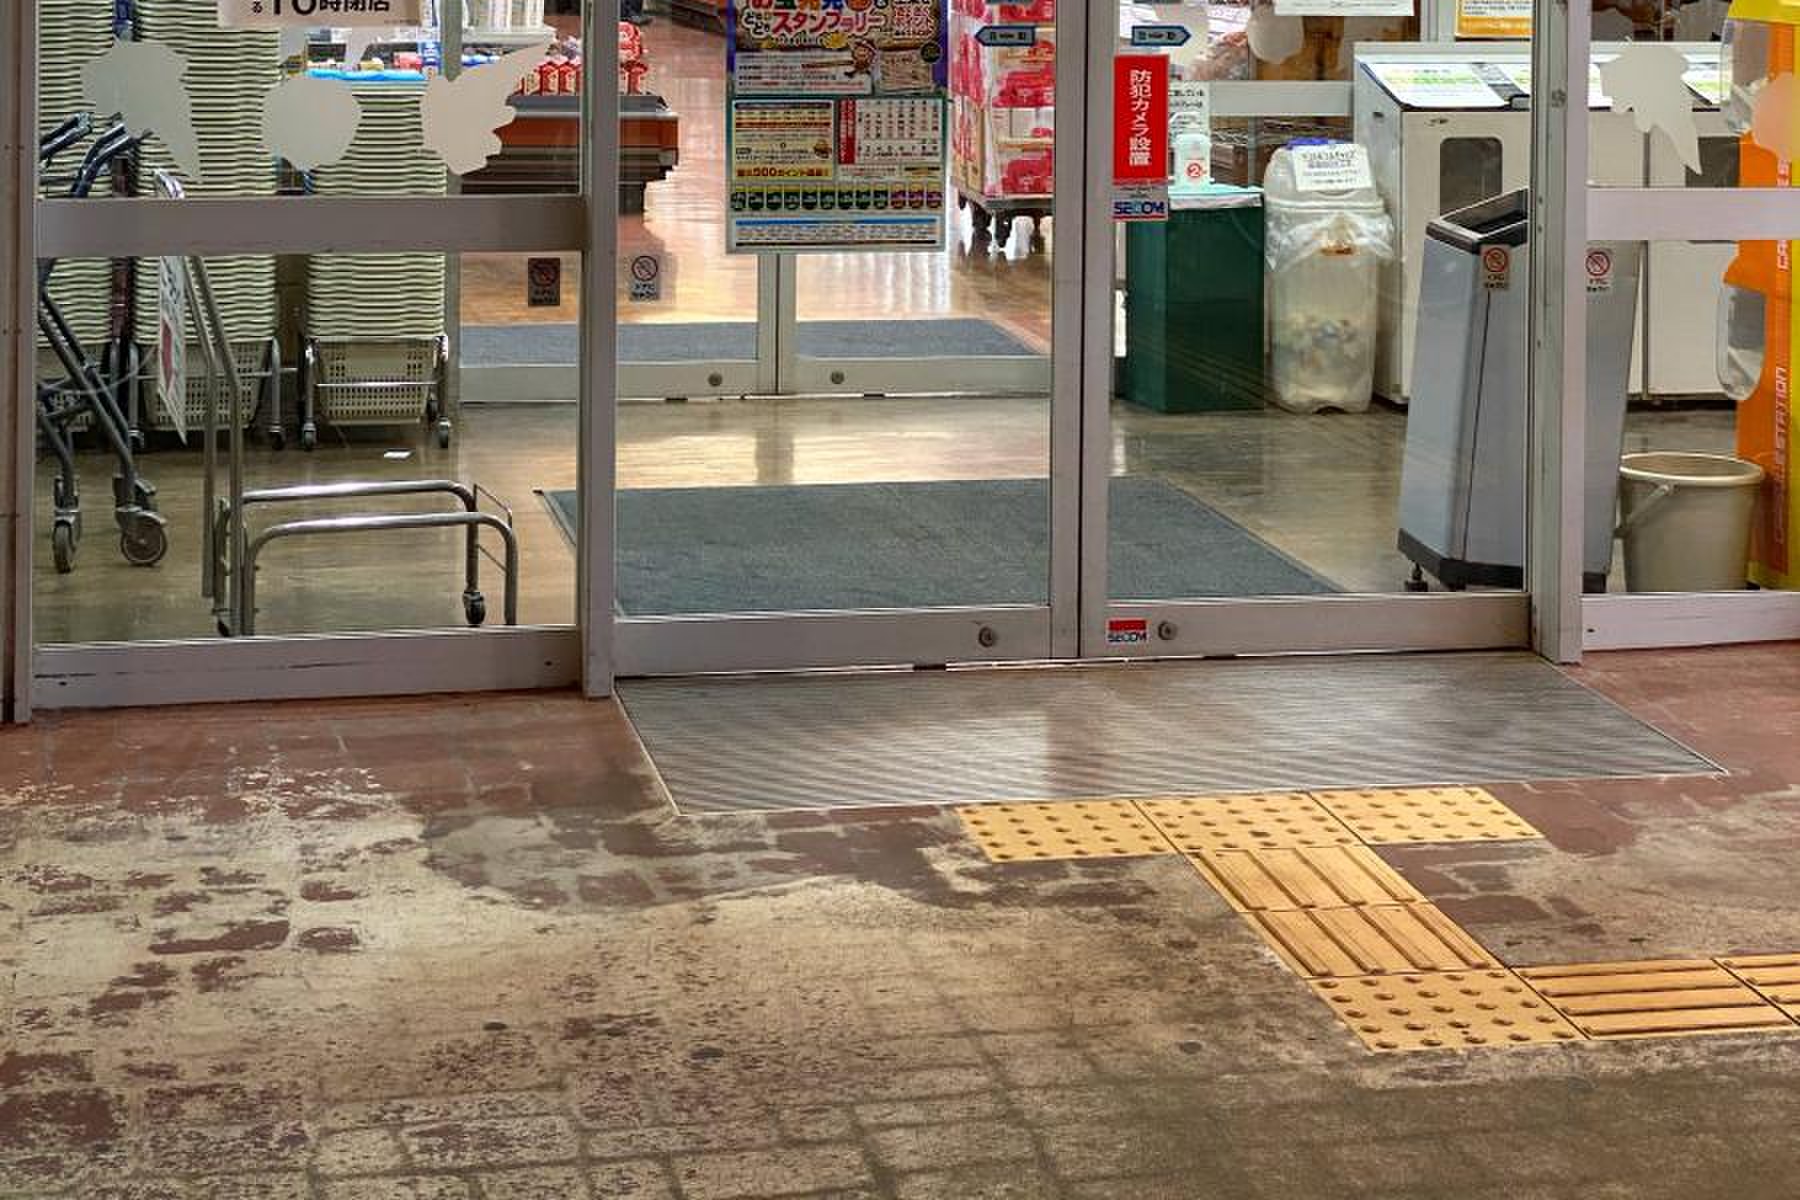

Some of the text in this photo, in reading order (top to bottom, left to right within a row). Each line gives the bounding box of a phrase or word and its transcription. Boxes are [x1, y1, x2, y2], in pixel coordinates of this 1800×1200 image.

[1129, 69, 1153, 167] 防犯カメラ設置
[1113, 201, 1165, 215] SECOM
